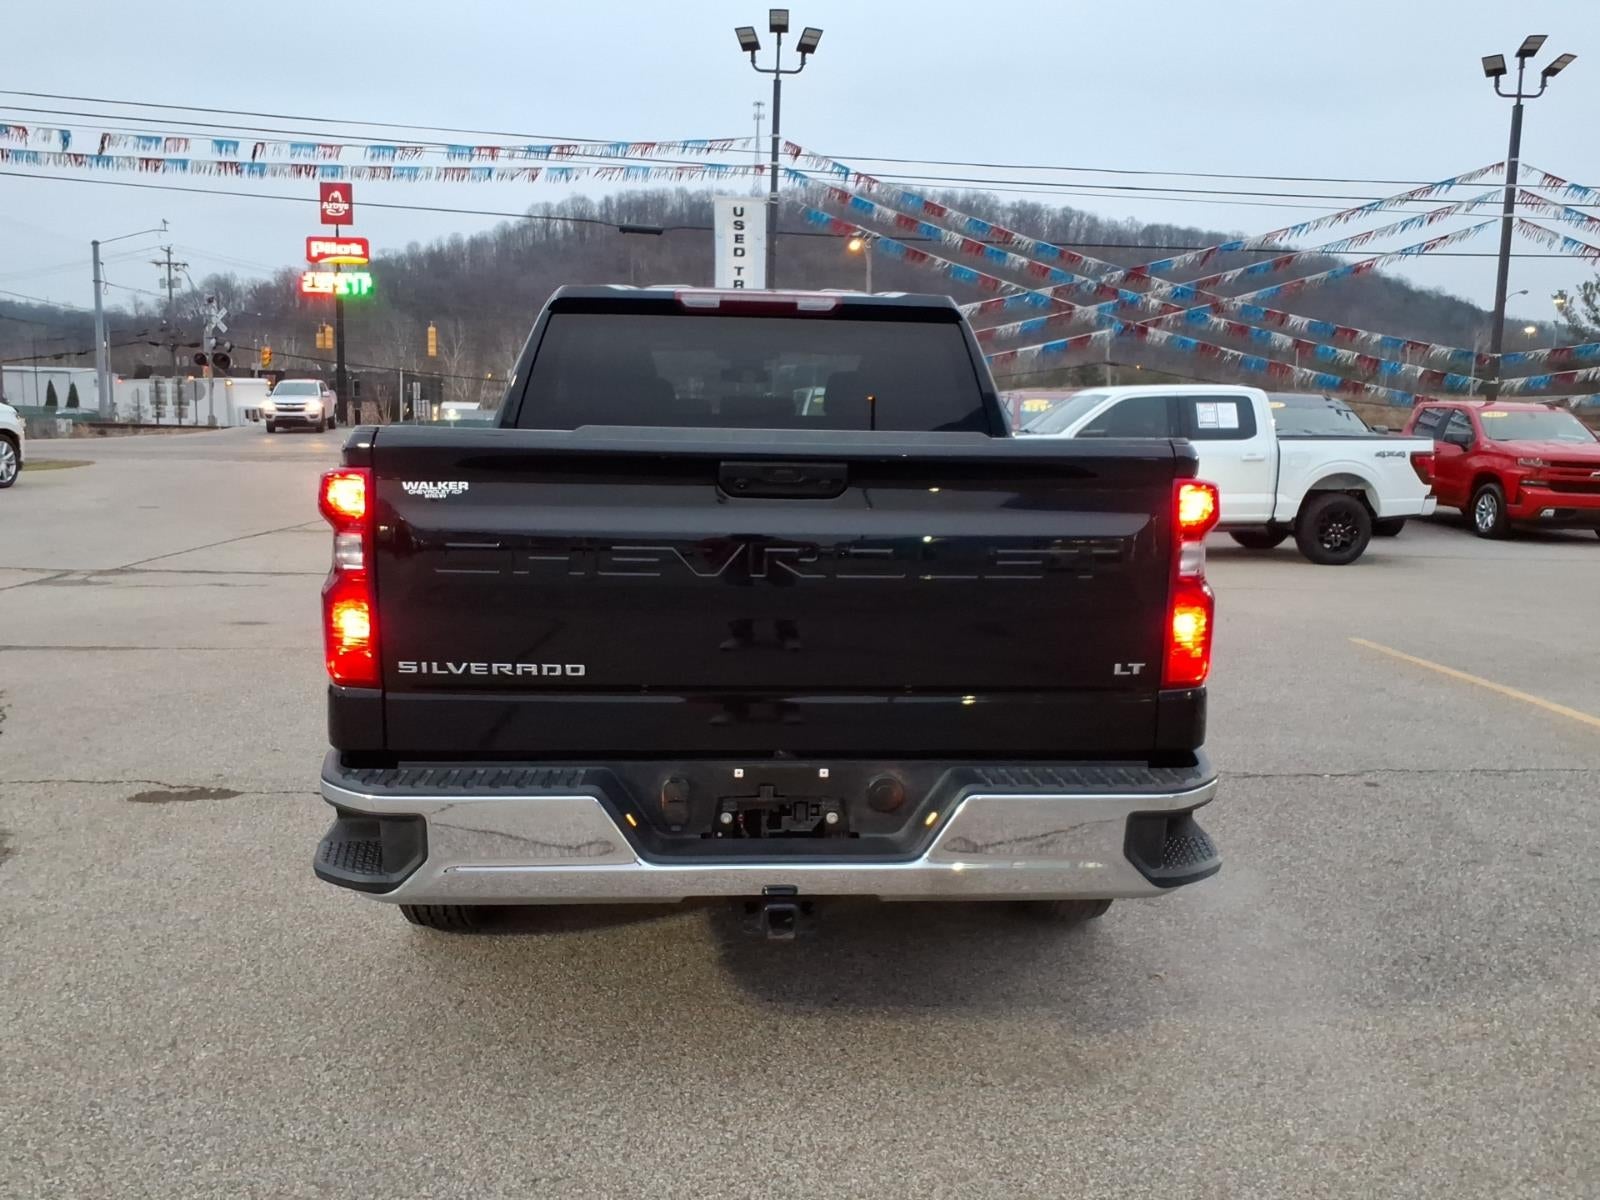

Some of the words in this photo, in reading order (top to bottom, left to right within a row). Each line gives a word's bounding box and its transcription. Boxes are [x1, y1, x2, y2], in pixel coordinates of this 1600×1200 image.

[733, 206, 745, 257] USED
[402, 481, 469, 490] WALKER
[398, 661, 586, 676] SILVERADO
[1114, 663, 1146, 675] LT
